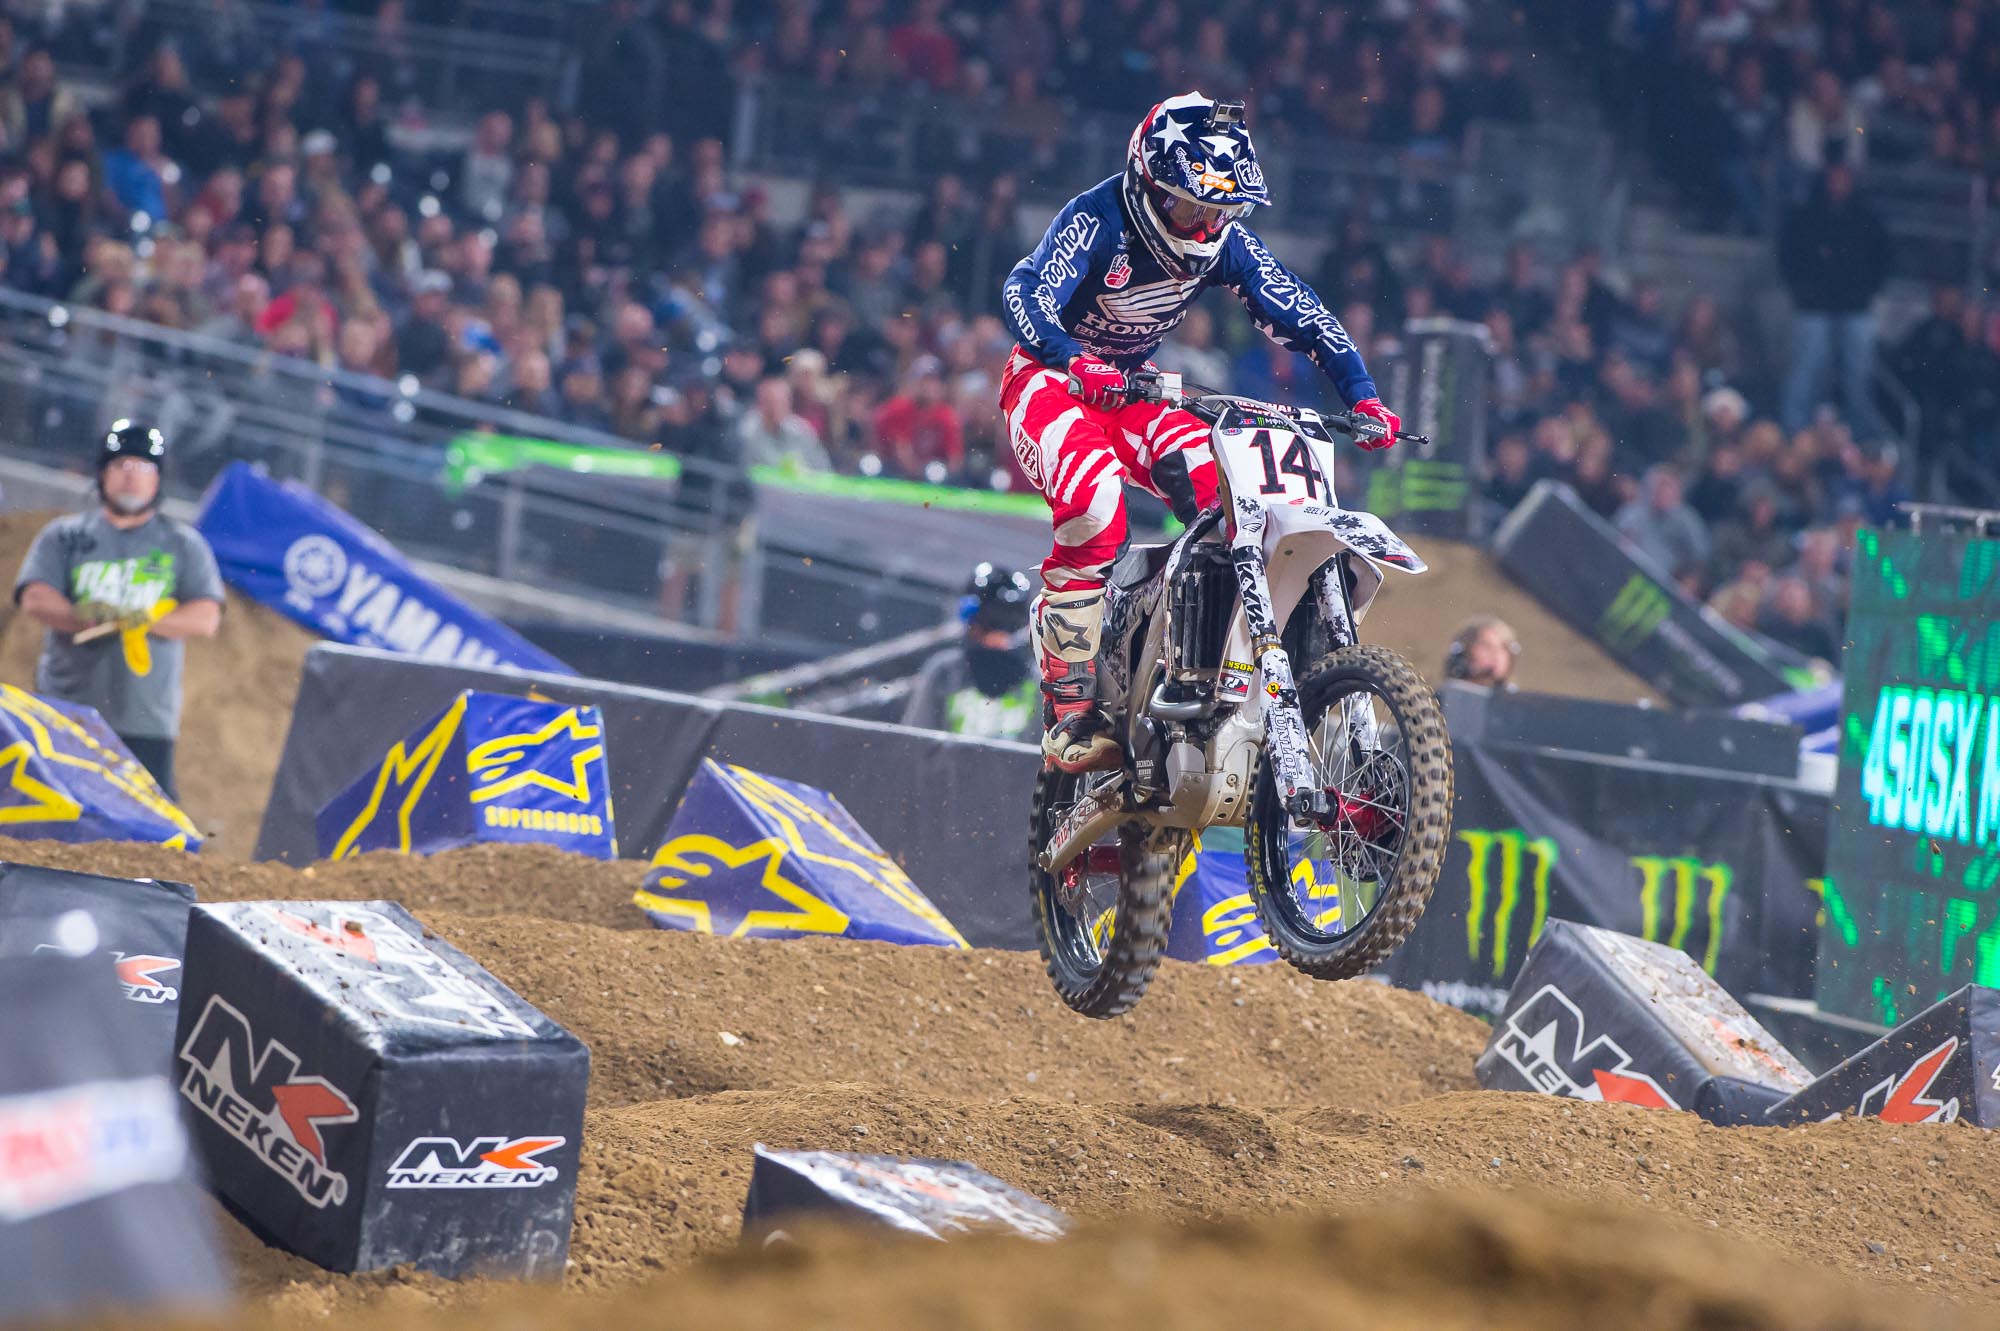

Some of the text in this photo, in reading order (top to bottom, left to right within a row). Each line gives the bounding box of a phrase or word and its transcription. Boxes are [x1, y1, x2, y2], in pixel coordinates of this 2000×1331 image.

[1082, 310, 1188, 335] HONDA
[1249, 429, 1323, 500] 14
[336, 562, 518, 669] YAMAH
[1236, 560, 1265, 625] KYB
[1861, 684, 1985, 846] 450SX
[484, 805, 603, 836] SUPERCROSS
[182, 1065, 337, 1203] NEKEN
[392, 1170, 547, 1186] NEKEN
